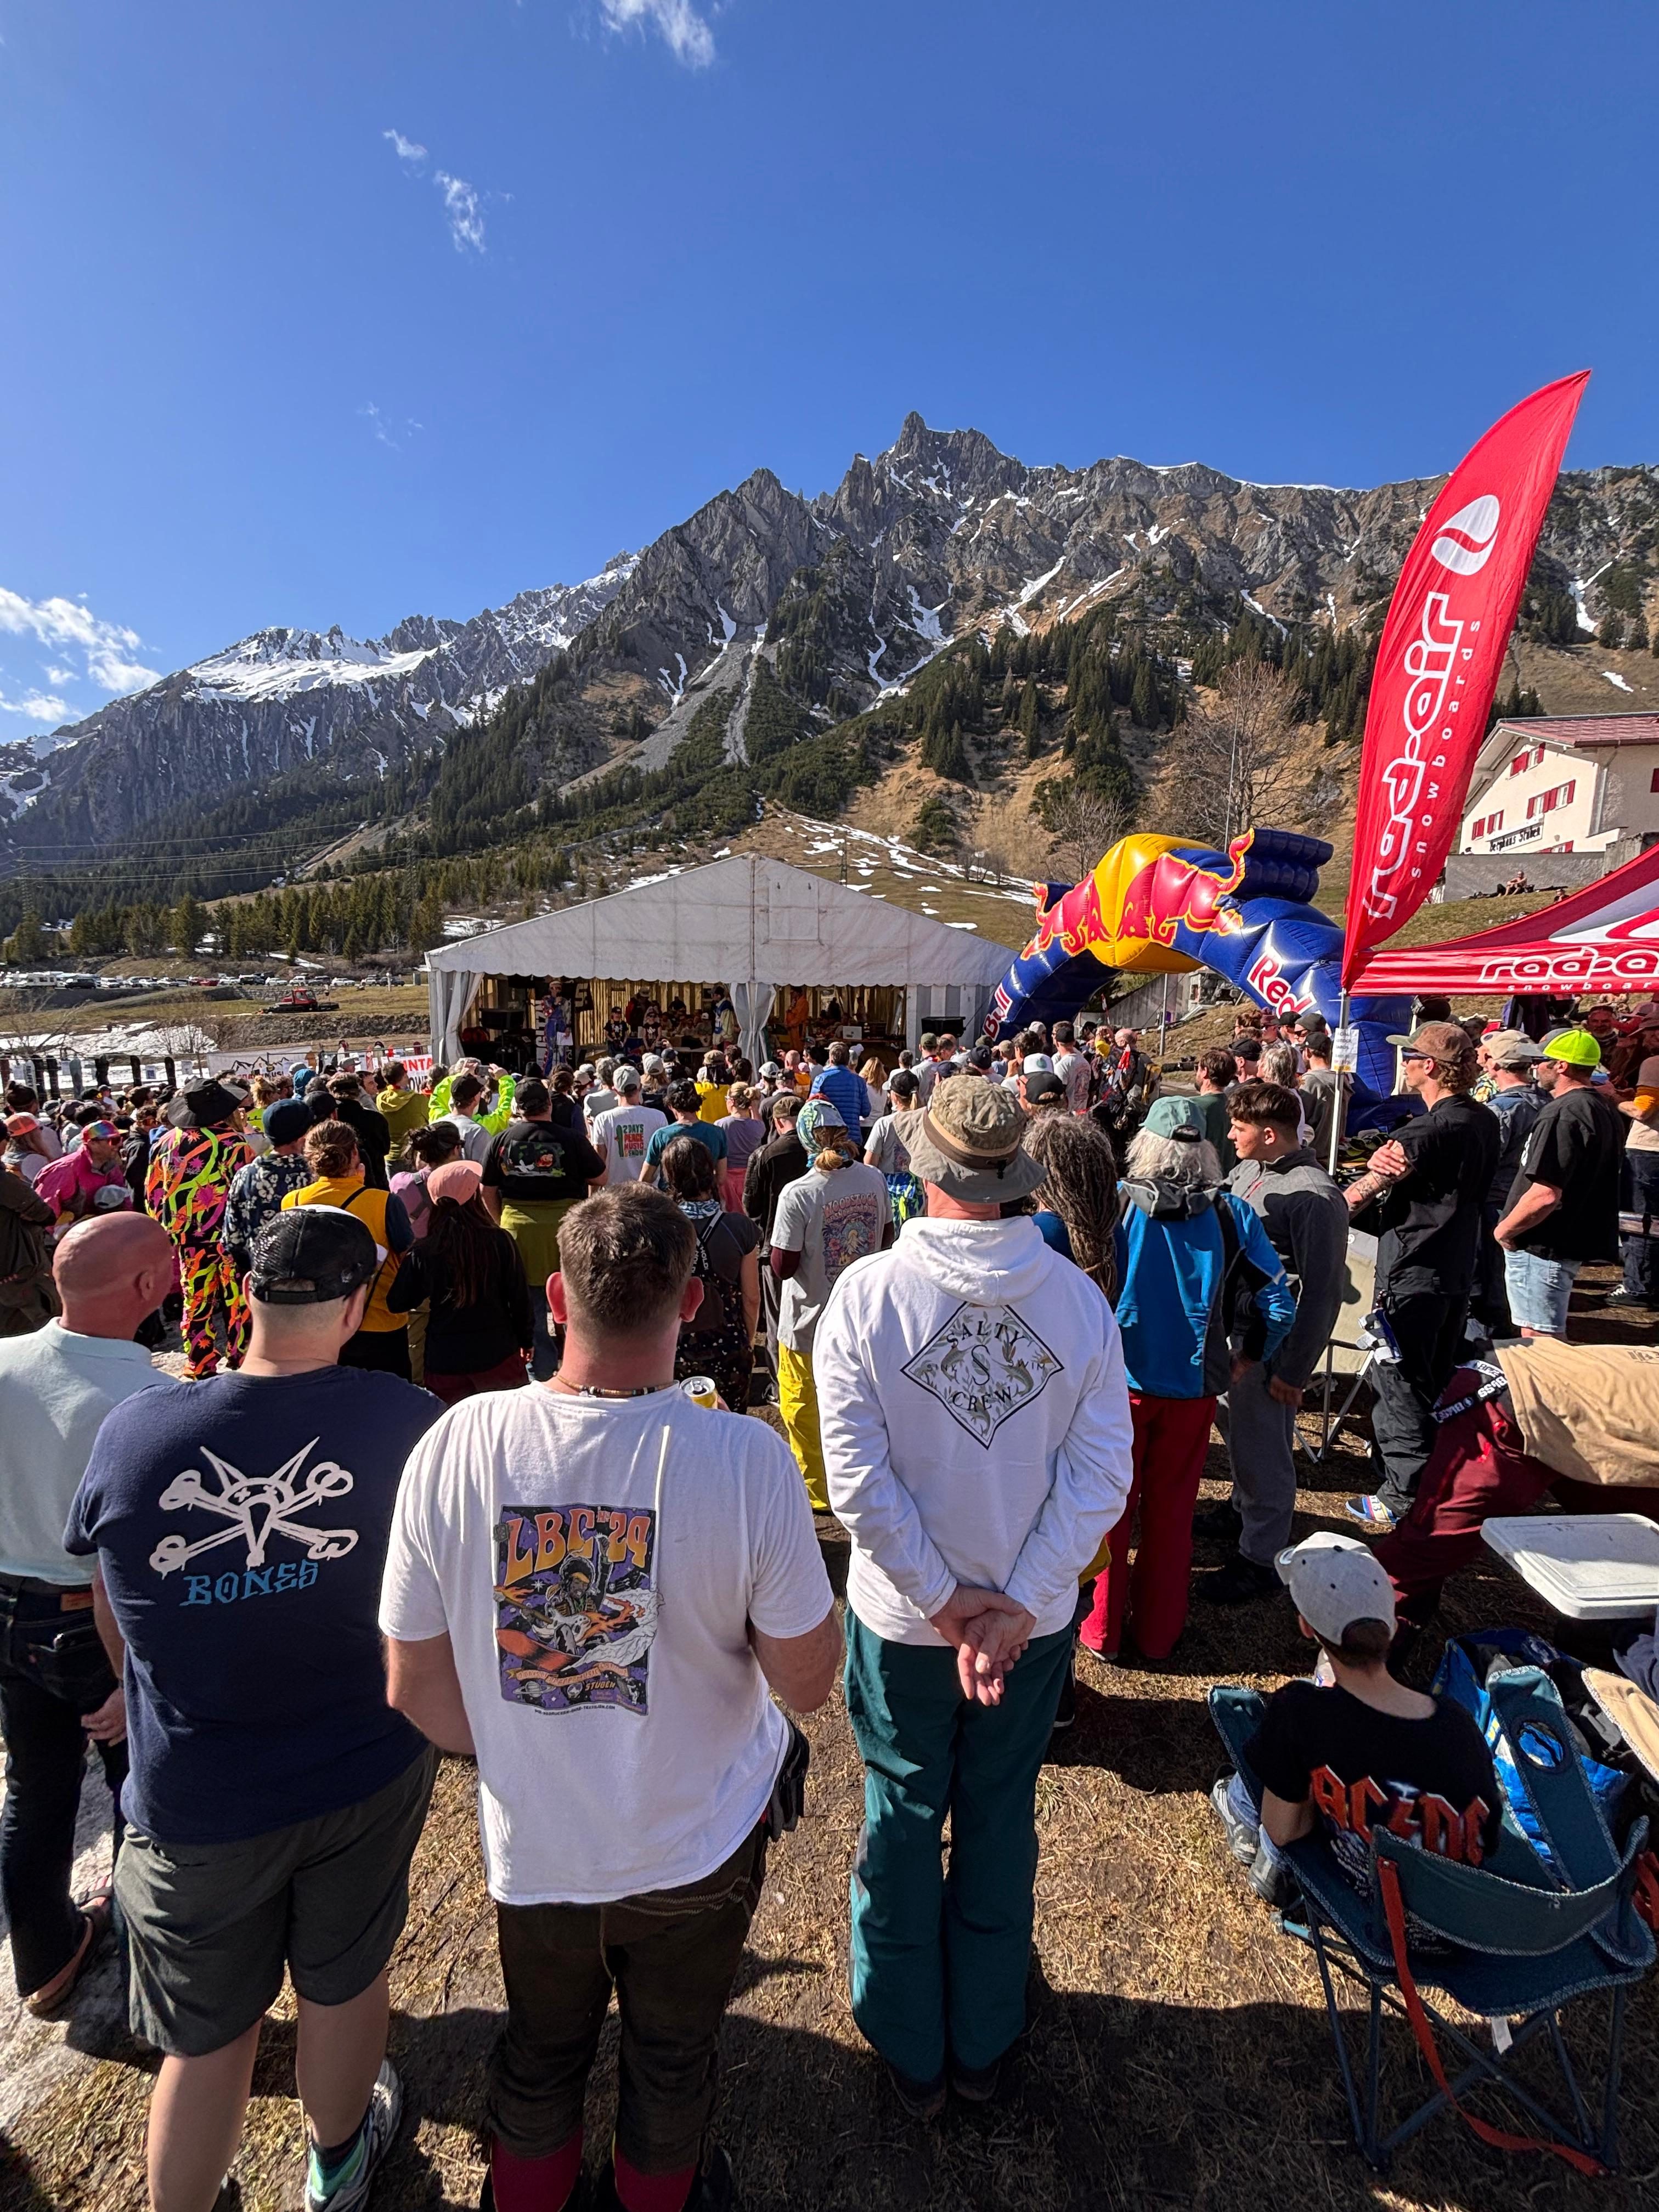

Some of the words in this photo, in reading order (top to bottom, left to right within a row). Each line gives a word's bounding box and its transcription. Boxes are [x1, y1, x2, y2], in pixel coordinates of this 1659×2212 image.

[1410, 620, 1480, 878] snowboards
[1249, 951, 1316, 1018] Red
[983, 983, 1013, 1041] Bull
[628, 1124, 644, 1133] DAYS
[624, 1142, 644, 1150] MUSIC
[823, 1192, 877, 1219] WOODSTOCK
[947, 1321, 1026, 1348] SALTY
[1007, 1361, 1046, 1371] SWIM
[952, 1386, 1013, 1412] CREW
[504, 1508, 595, 1587] LBC
[179, 1559, 319, 1606] BONES
